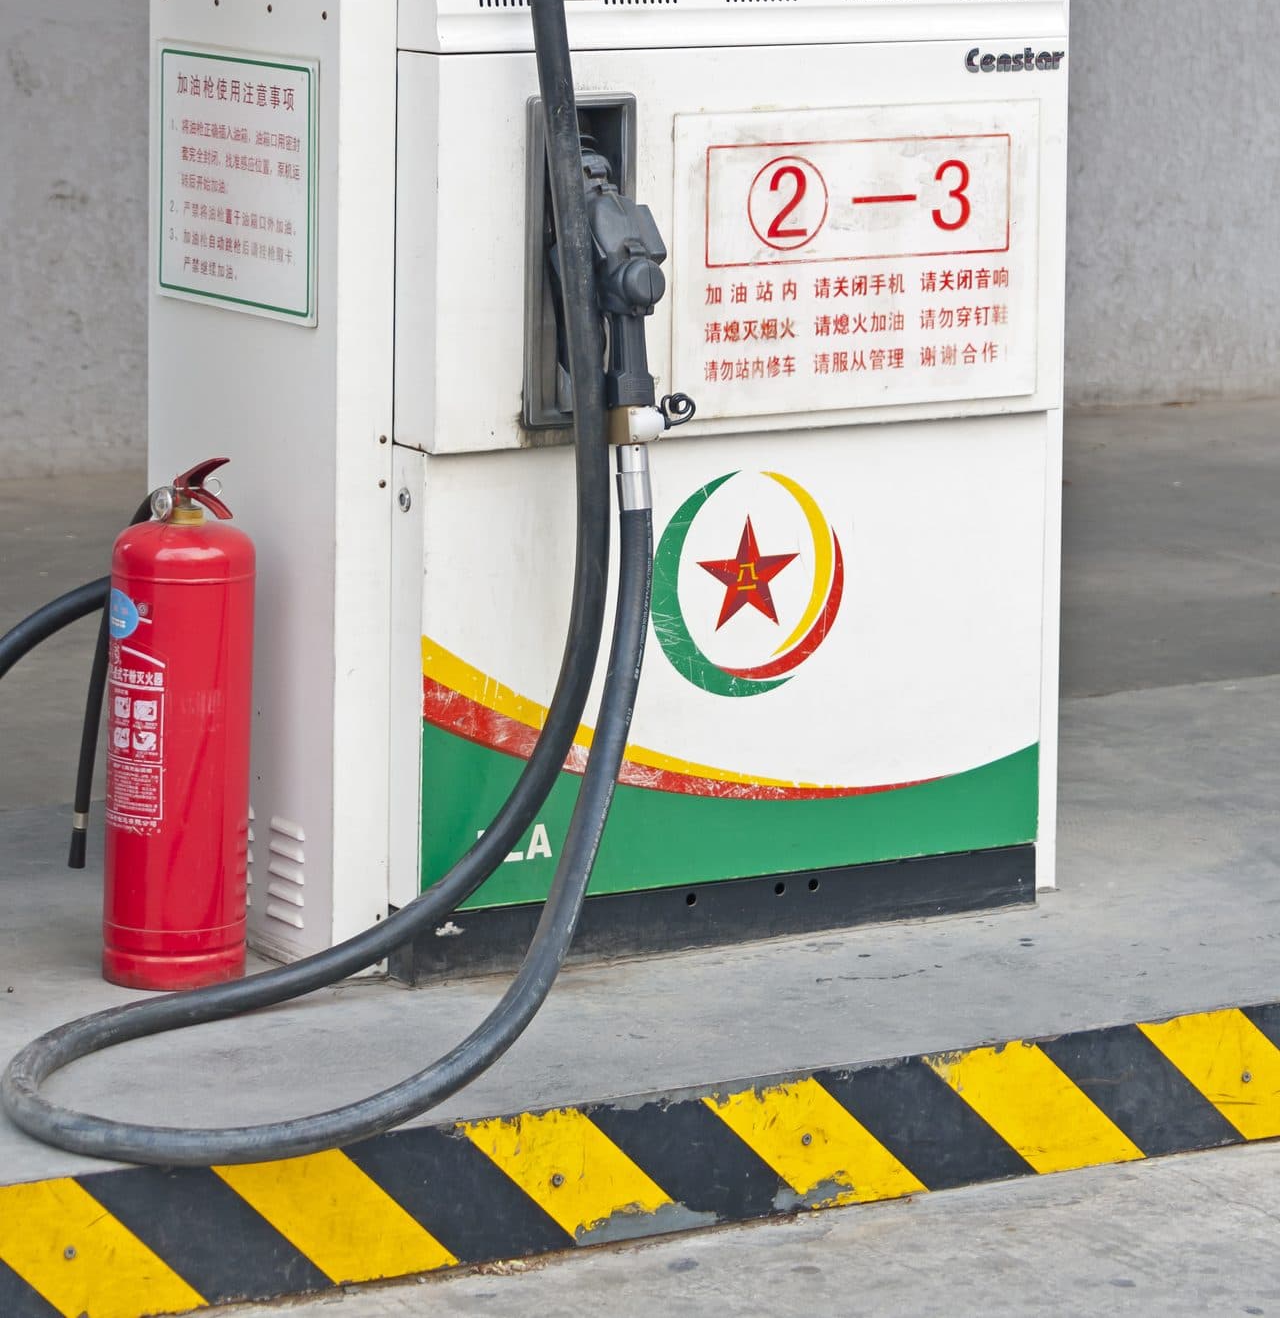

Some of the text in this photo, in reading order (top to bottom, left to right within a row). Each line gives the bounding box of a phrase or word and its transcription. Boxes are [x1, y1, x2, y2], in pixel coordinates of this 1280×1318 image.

[965, 47, 1065, 73] Censtar
[177, 70, 295, 112] 加油枪使用注意事项
[705, 266, 1009, 305] 加油站内 请关闭手机 请关闭音响
[705, 304, 1008, 343] 请熄灭烟火 请熄火加油 请勿穿钉鞋
[704, 355, 795, 382] 请勿站内修车
[814, 346, 905, 374] 请服从管理
